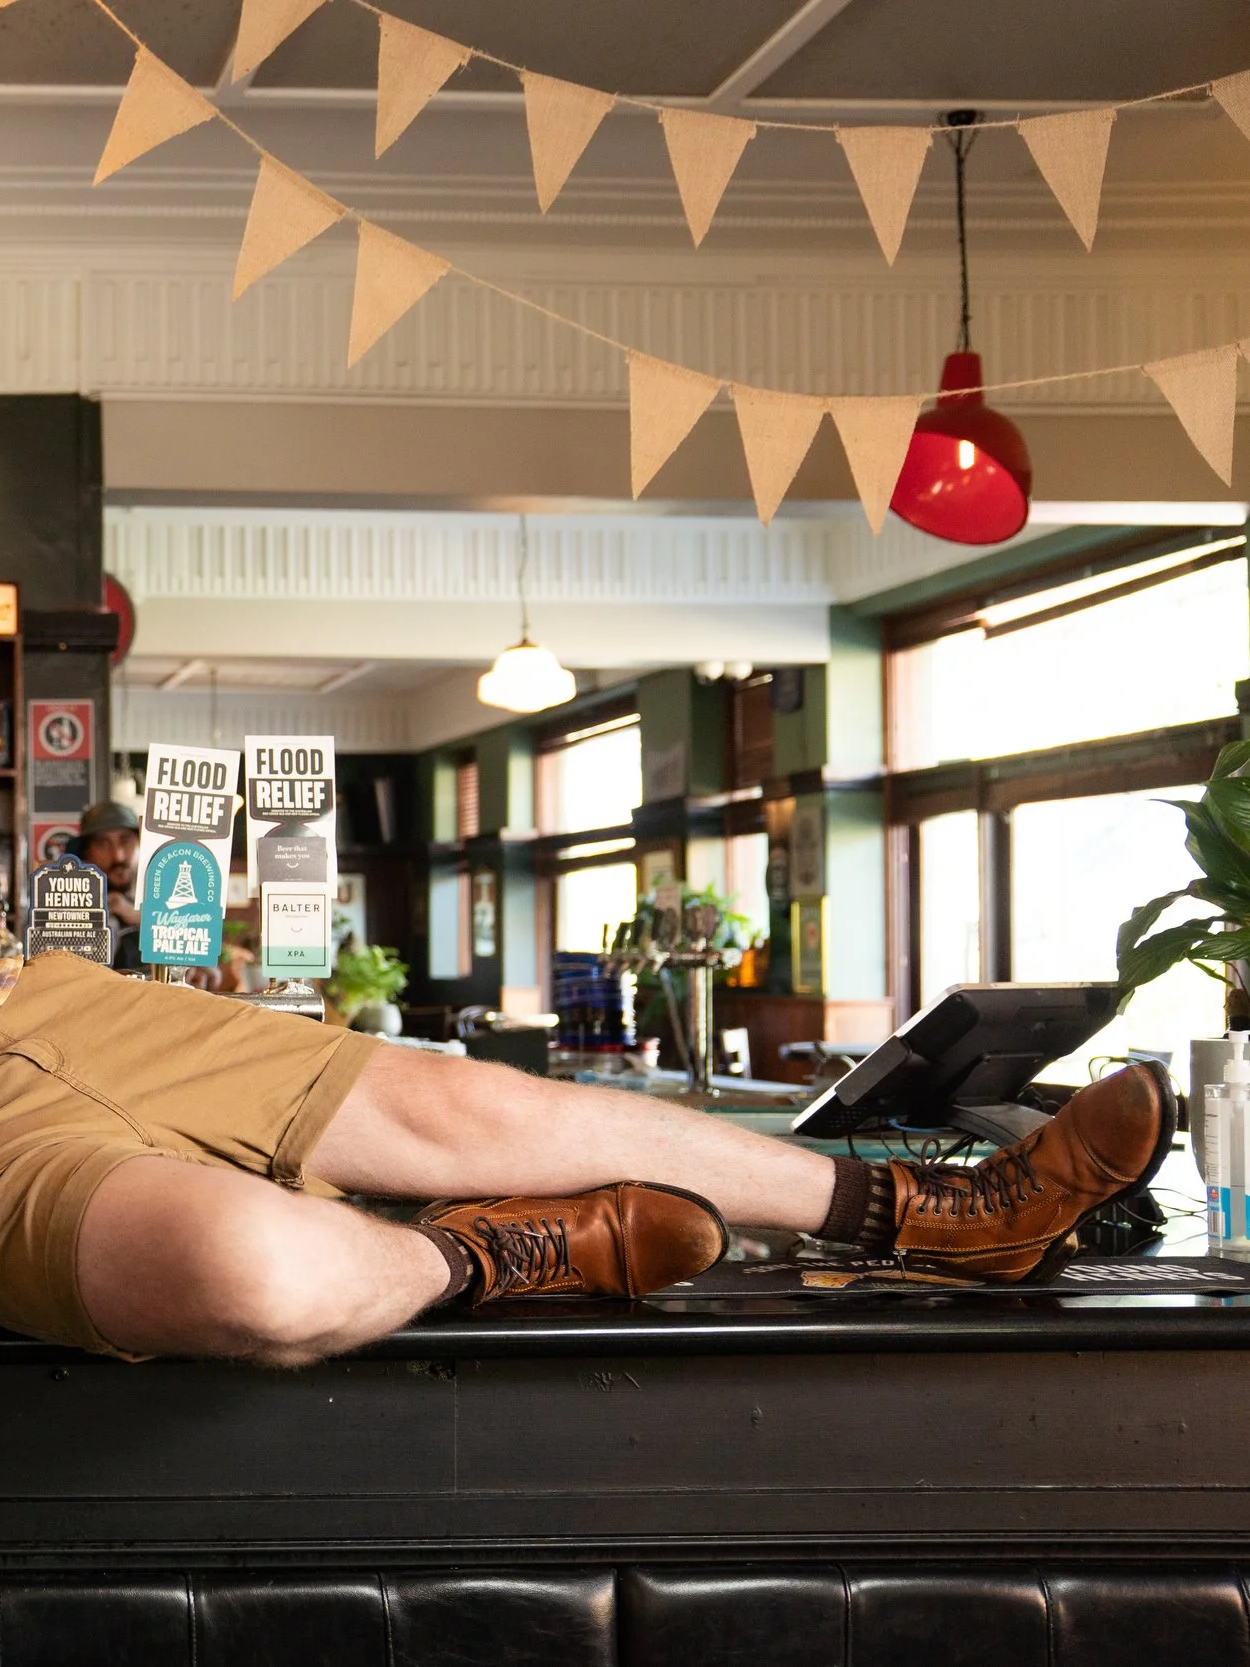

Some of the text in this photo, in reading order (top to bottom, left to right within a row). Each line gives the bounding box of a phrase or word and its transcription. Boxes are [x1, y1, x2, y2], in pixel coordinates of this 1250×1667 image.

[256, 748, 323, 775] FLOOD
[157, 757, 227, 790] FLOOD
[256, 780, 326, 809] RELIEF
[152, 790, 225, 826] RELIEF
[274, 852, 310, 861] makes you
[153, 848, 215, 903] GREEN BEACON BREWING CO
[48, 877, 91, 893] YOUNG
[44, 892, 94, 907] HENRYS
[273, 903, 320, 912] BALTER
[48, 911, 91, 921] NEWTOWNER
[42, 930, 97, 938] AUSTRALIAN PALE ALE
[152, 925, 211, 943] TROPICAL
[152, 939, 210, 956] PALE ALE
[1059, 1272, 1246, 1281] HENRYS
